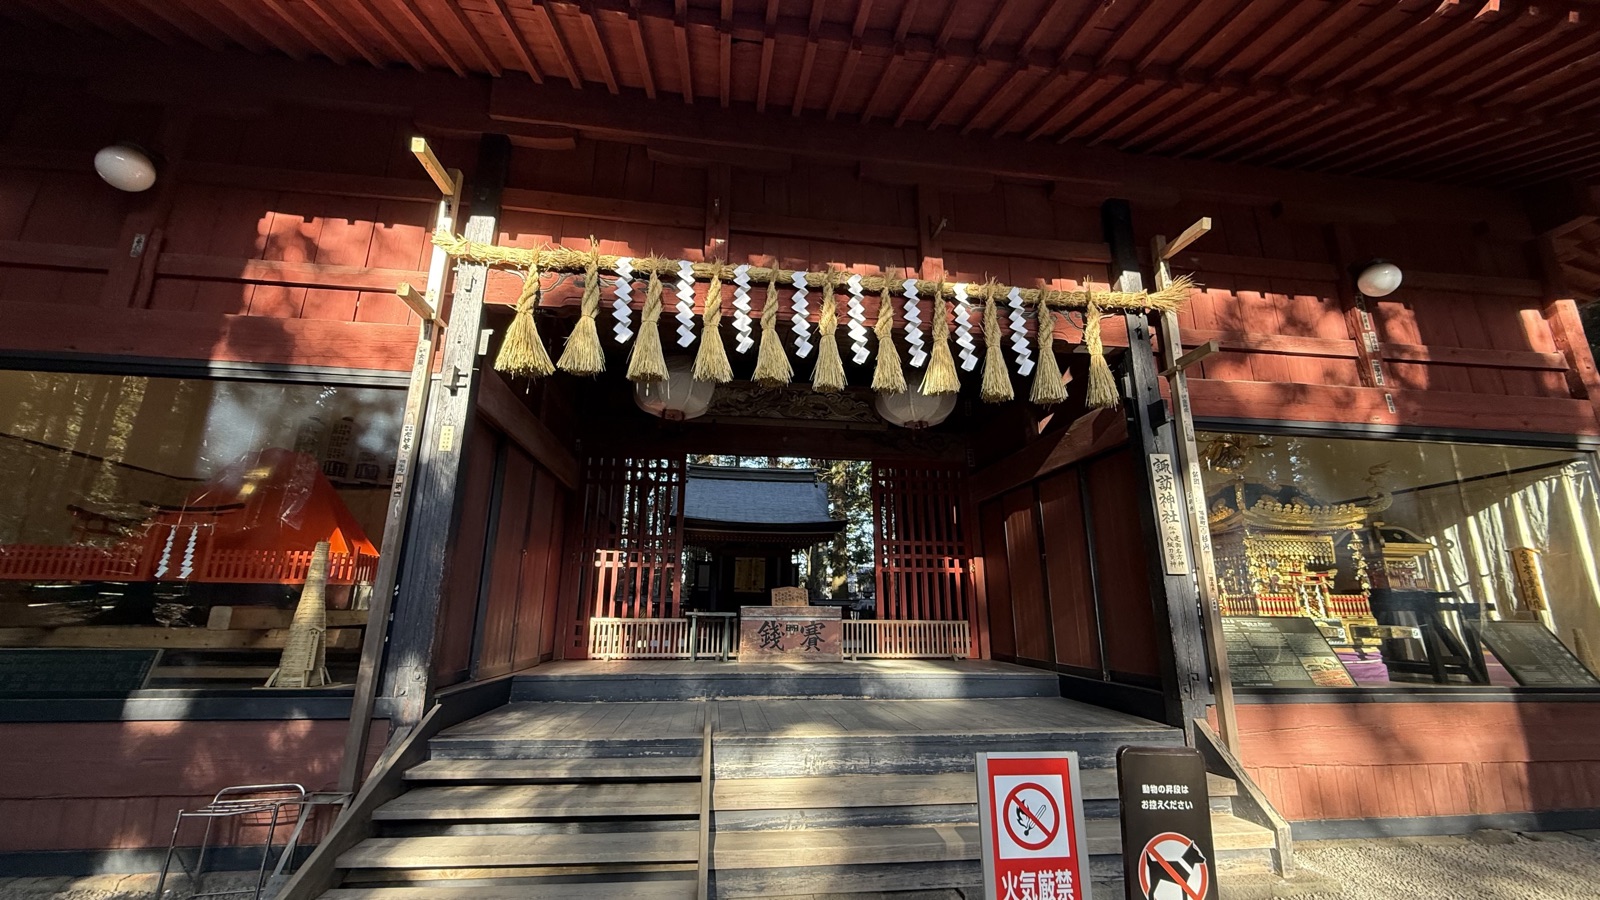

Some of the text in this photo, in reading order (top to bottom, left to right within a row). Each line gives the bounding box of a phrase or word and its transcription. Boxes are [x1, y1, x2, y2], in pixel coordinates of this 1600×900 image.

[1153, 459, 1180, 523] 諏訪神社
[1141, 784, 1189, 795] 動物の昇段は
[1141, 800, 1193, 810] お控えください
[1002, 869, 1074, 900] 火気厳禁
